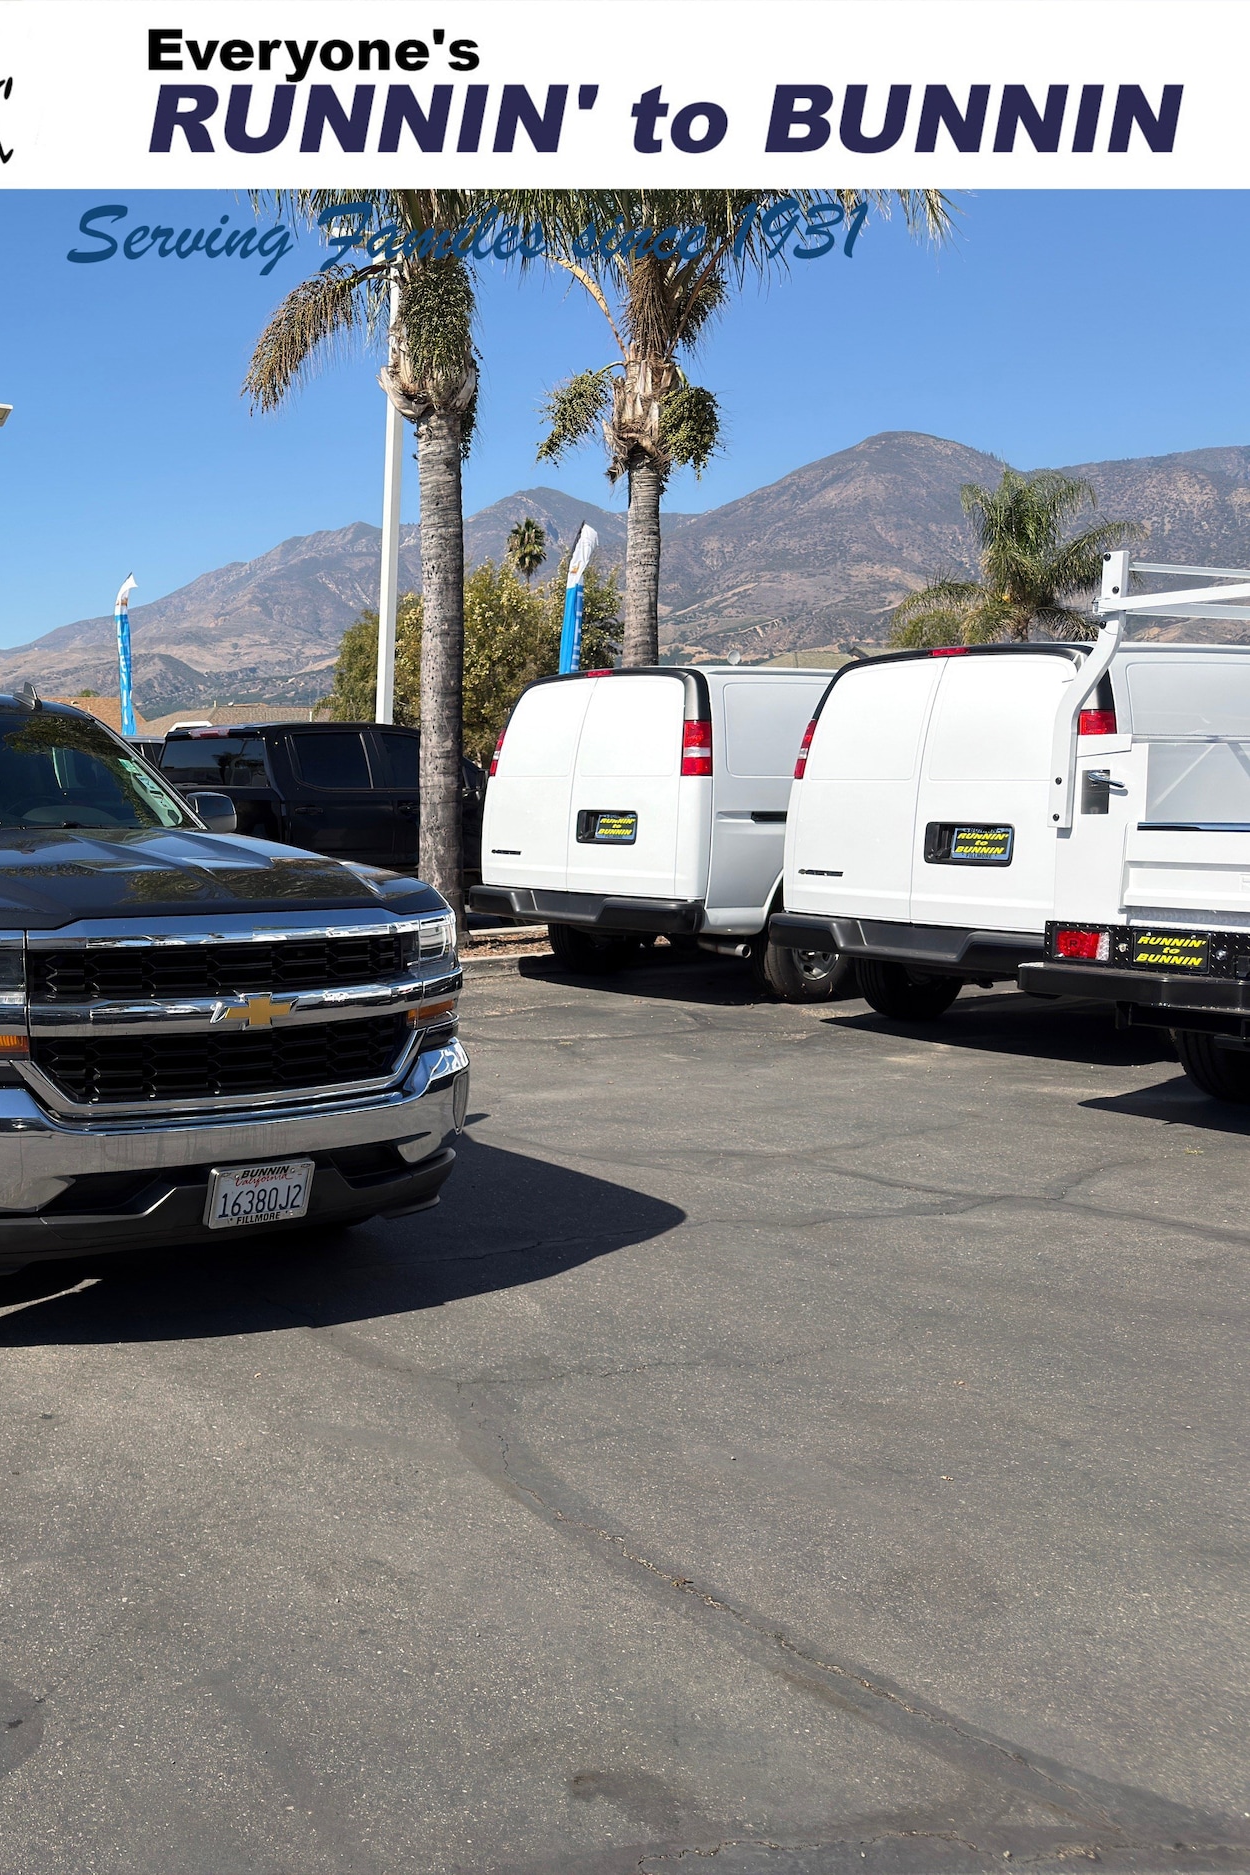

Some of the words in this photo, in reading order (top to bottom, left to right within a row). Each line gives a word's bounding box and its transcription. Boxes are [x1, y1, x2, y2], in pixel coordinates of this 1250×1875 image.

[957, 832, 1010, 841] RUNNIN'
[955, 846, 1005, 855] BUNNIN
[1137, 936, 1207, 948] RUNNIN'
[1162, 946, 1181, 955] to
[1135, 953, 1203, 966] BUNNIN
[241, 1166, 290, 1179] BUNNIN
[218, 1184, 303, 1219] 16380J2
[236, 1211, 281, 1225] FILLMORE
